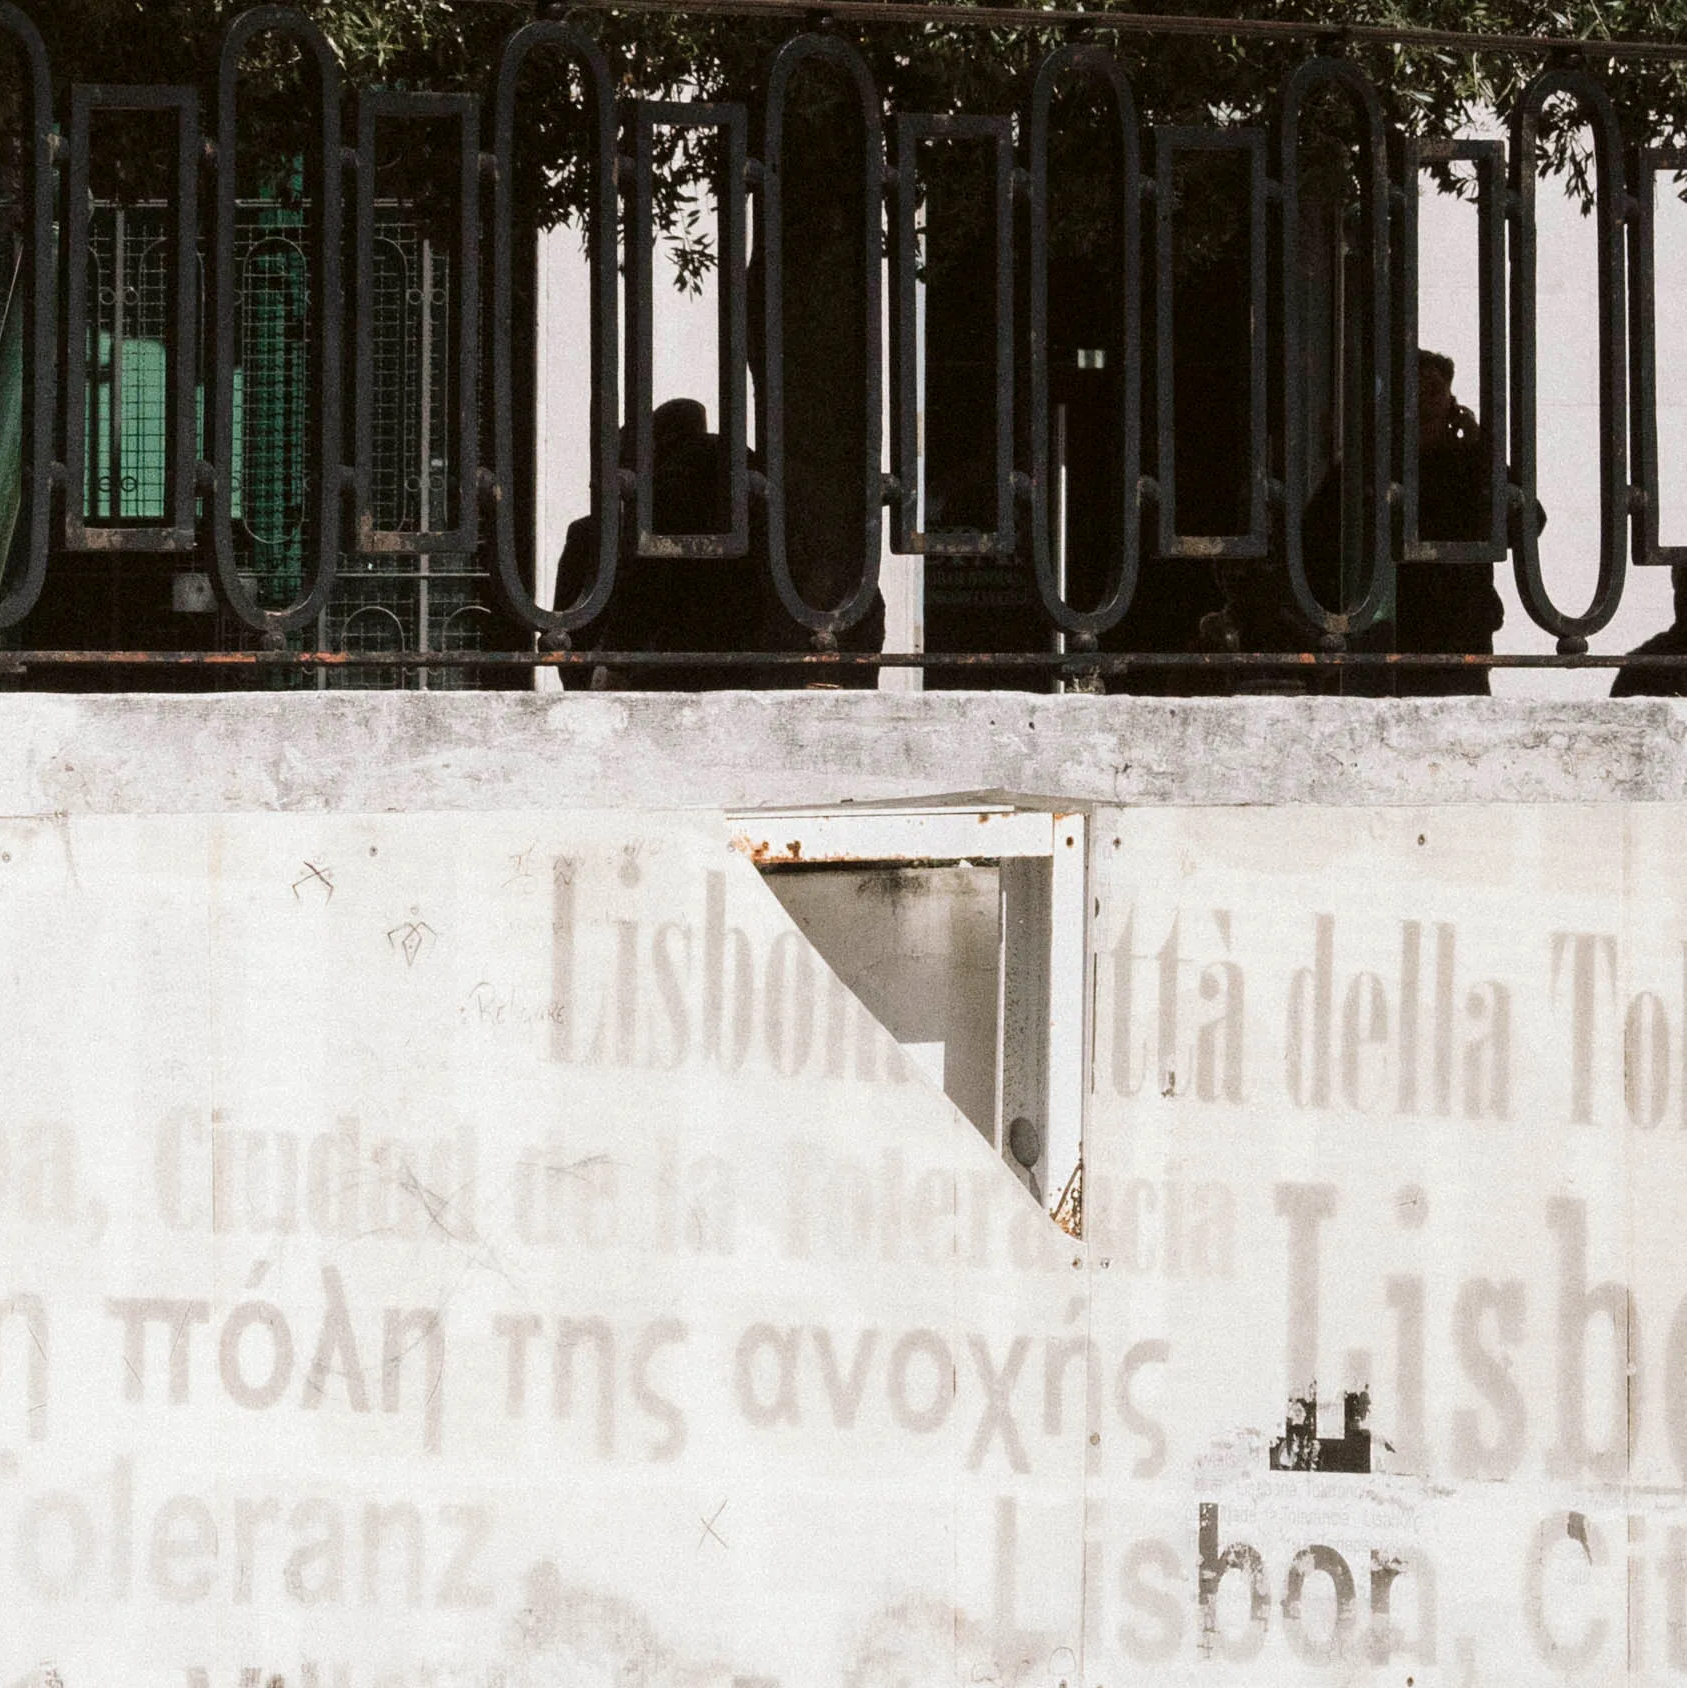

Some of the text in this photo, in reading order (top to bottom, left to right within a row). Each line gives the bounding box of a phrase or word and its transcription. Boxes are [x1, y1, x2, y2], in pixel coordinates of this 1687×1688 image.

[1283, 911, 1515, 1124] della
[105, 1256, 447, 1456] πόλη
[493, 1310, 692, 1464] της
[732, 1292, 1173, 1479] ανοχής
[1268, 1178, 1687, 1482] Lisb
